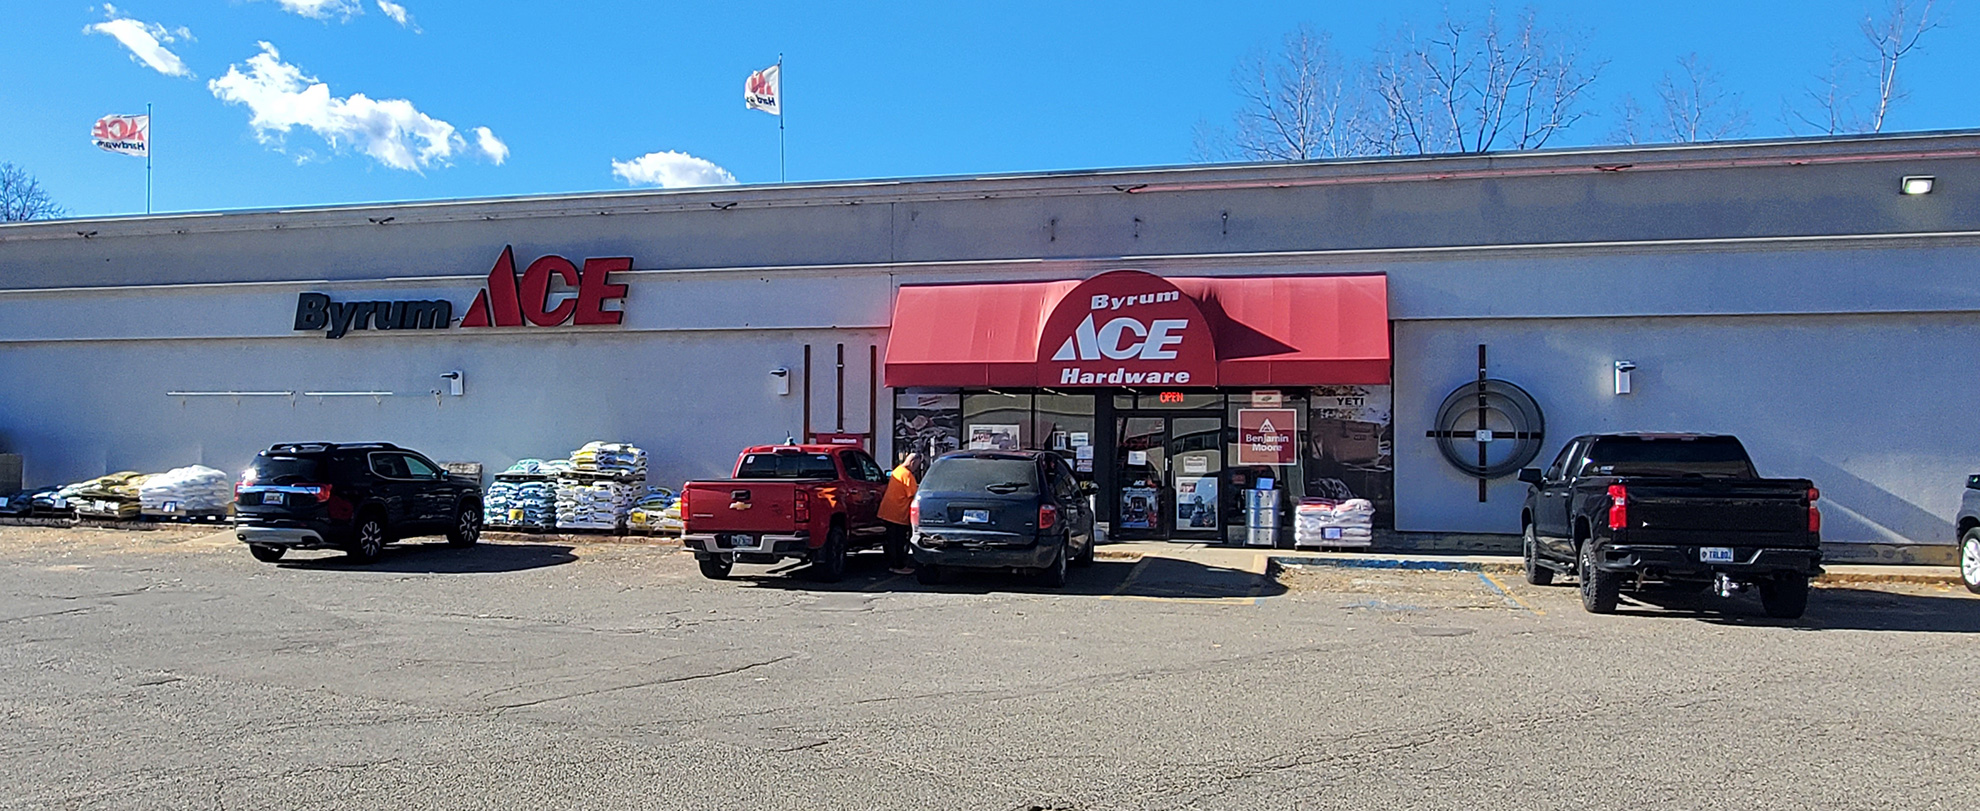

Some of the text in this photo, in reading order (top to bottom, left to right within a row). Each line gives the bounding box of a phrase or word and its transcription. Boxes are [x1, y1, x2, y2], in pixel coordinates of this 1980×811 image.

[294, 244, 634, 339] Byrum ACE
[1091, 290, 1180, 310] Byrum
[1051, 312, 1189, 361] ACE
[1060, 368, 1190, 385] Hardware
[1160, 392, 1184, 403] OPEN
[1336, 397, 1364, 406] YETI
[1245, 434, 1289, 444] Benjamin
[1252, 443, 1283, 451] Moore
